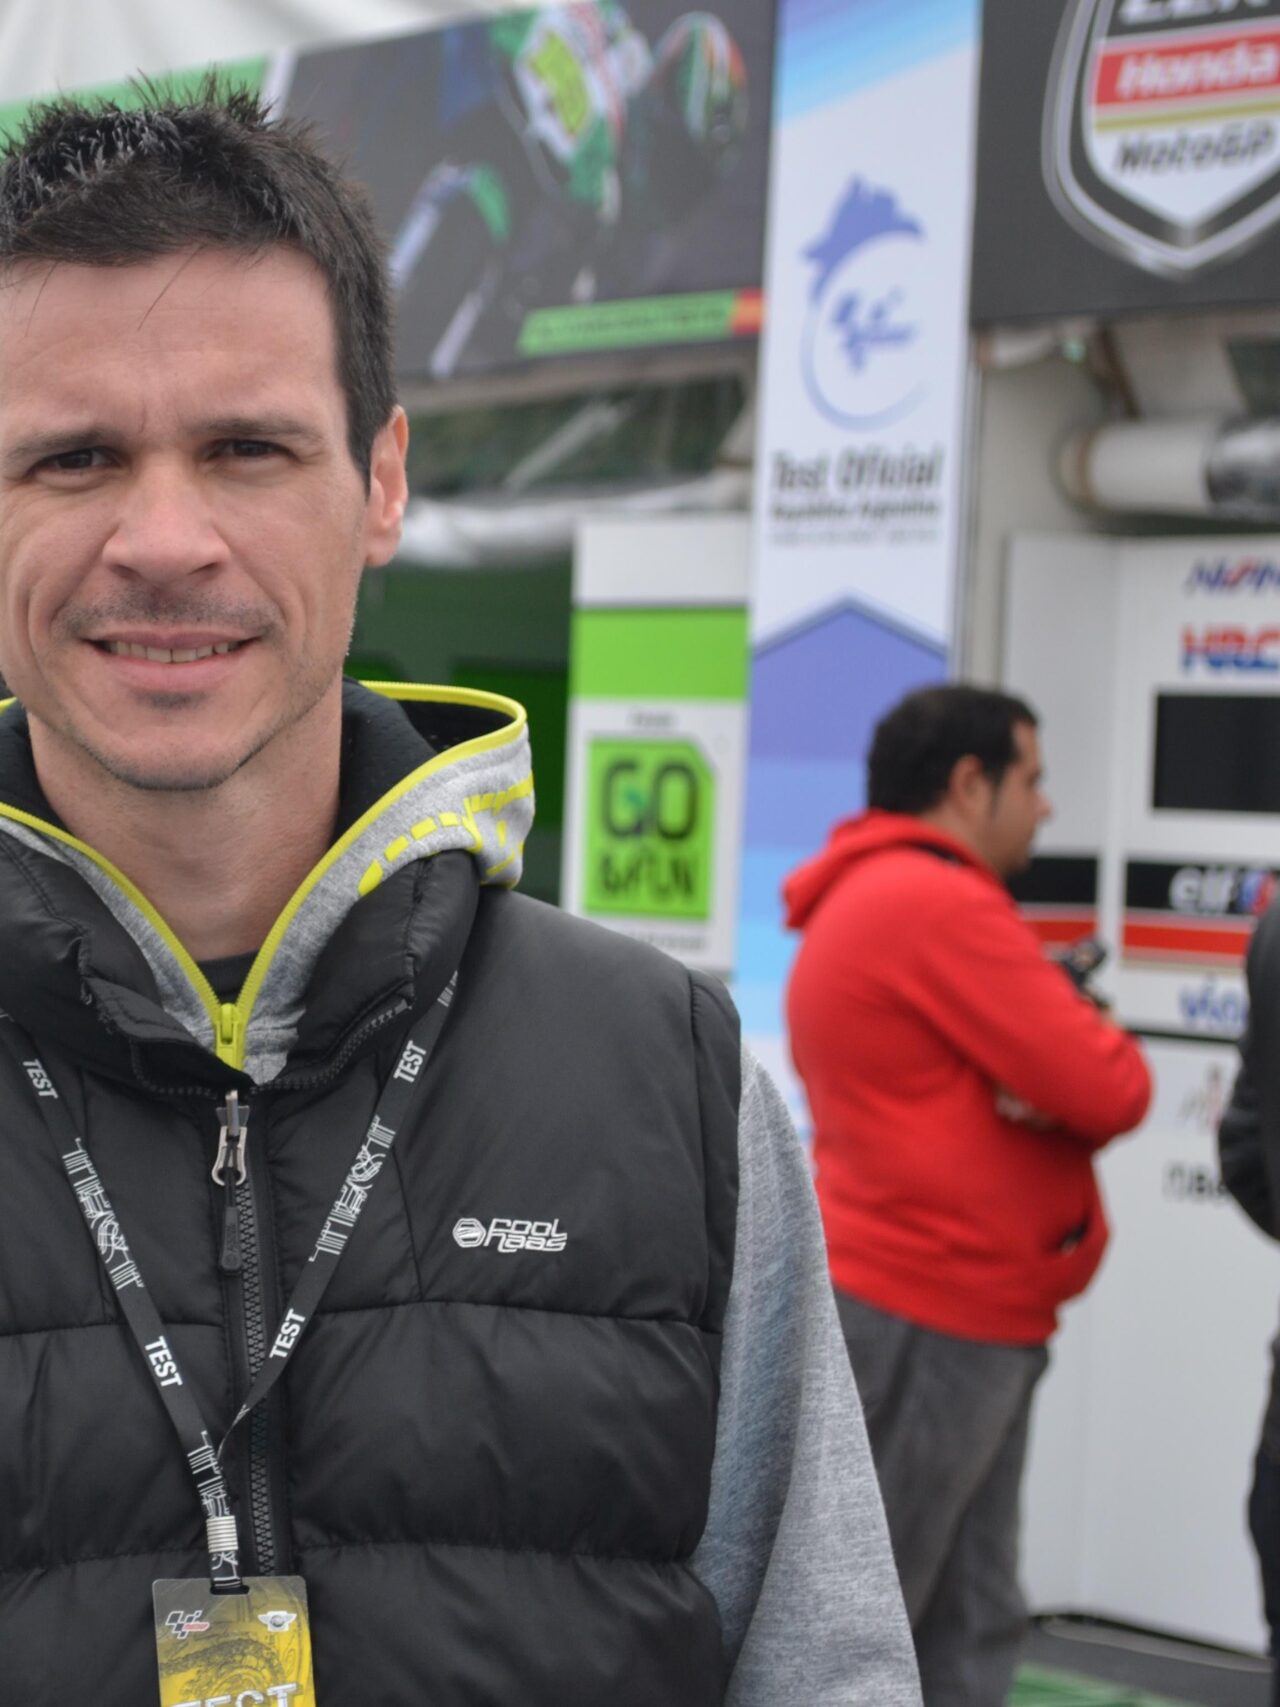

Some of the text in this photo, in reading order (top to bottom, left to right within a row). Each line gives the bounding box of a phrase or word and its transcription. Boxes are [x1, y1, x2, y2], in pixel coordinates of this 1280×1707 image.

[1116, 42, 1279, 99] Honda
[600, 756, 701, 843] GO
[23, 1058, 59, 1099] TEST
[393, 1040, 427, 1083] TEST
[270, 1308, 307, 1359] TEST
[144, 1335, 184, 1387] TEST
